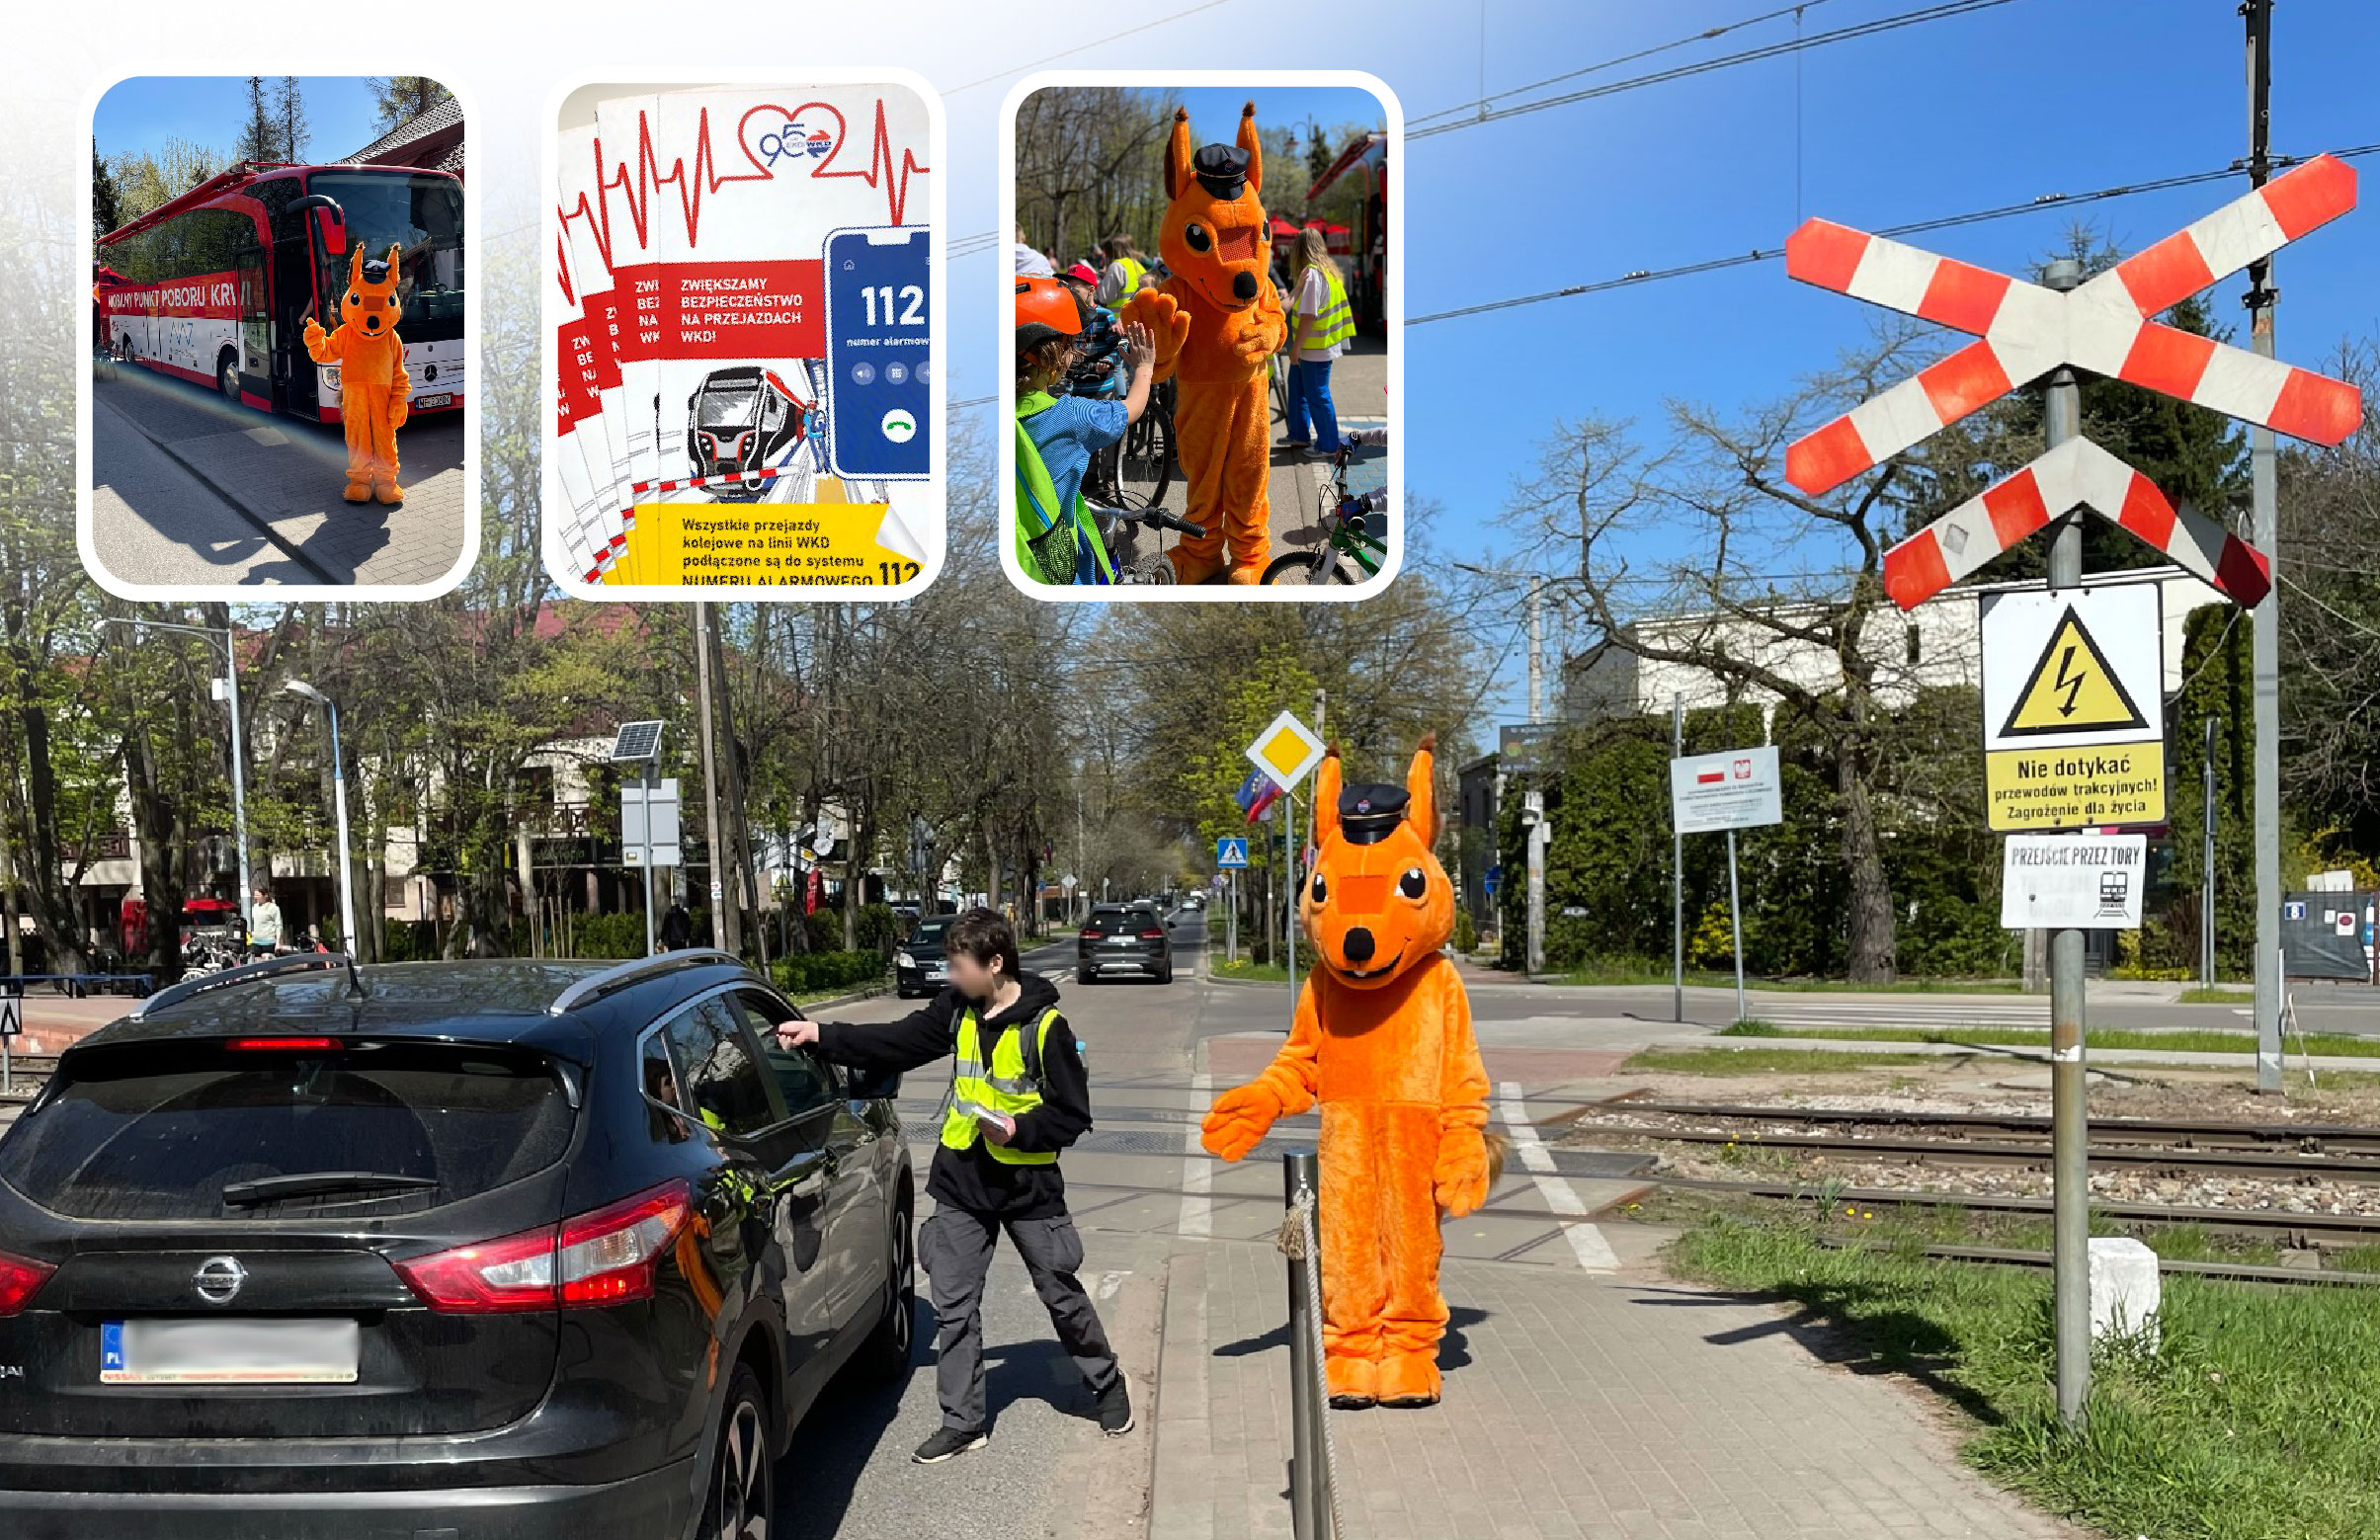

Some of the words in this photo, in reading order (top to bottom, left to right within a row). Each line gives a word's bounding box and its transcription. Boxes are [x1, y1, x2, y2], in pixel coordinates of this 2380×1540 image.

[681, 278, 768, 293] ZWIĘKSZAMY
[134, 289, 160, 307] PUNKT
[162, 285, 205, 307] POBORU
[681, 292, 803, 308] BEZPIECZEŃSTWO
[862, 284, 926, 326] 112
[681, 313, 700, 325] NA
[703, 311, 802, 325] PRZEJAZDACH
[681, 330, 716, 343] WKD!
[846, 338, 881, 347] numer
[682, 519, 750, 533] Wszystkie
[754, 519, 820, 533] przejazdy
[682, 536, 743, 550] kolejowe
[748, 539, 764, 548] na
[769, 536, 792, 548] linii
[796, 536, 830, 548] WKD
[683, 554, 761, 569] podłączone
[766, 557, 780, 569] są
[785, 554, 801, 566] do
[806, 557, 863, 569] systemu
[2017, 760, 2047, 779] Nie
[2055, 754, 2131, 779] dotykać
[1995, 782, 2068, 802] przewodów
[2074, 778, 2158, 796] trakcyjnych!
[2008, 803, 2080, 821] Zagrożenie
[2085, 802, 2104, 815] dla
[2110, 800, 2146, 815] życia
[2011, 844, 2070, 866] PRZEJŚCIE
[2071, 846, 2107, 865] PRZEZ
[2110, 846, 2140, 865] TORY
[107, 1351, 123, 1364] PL
